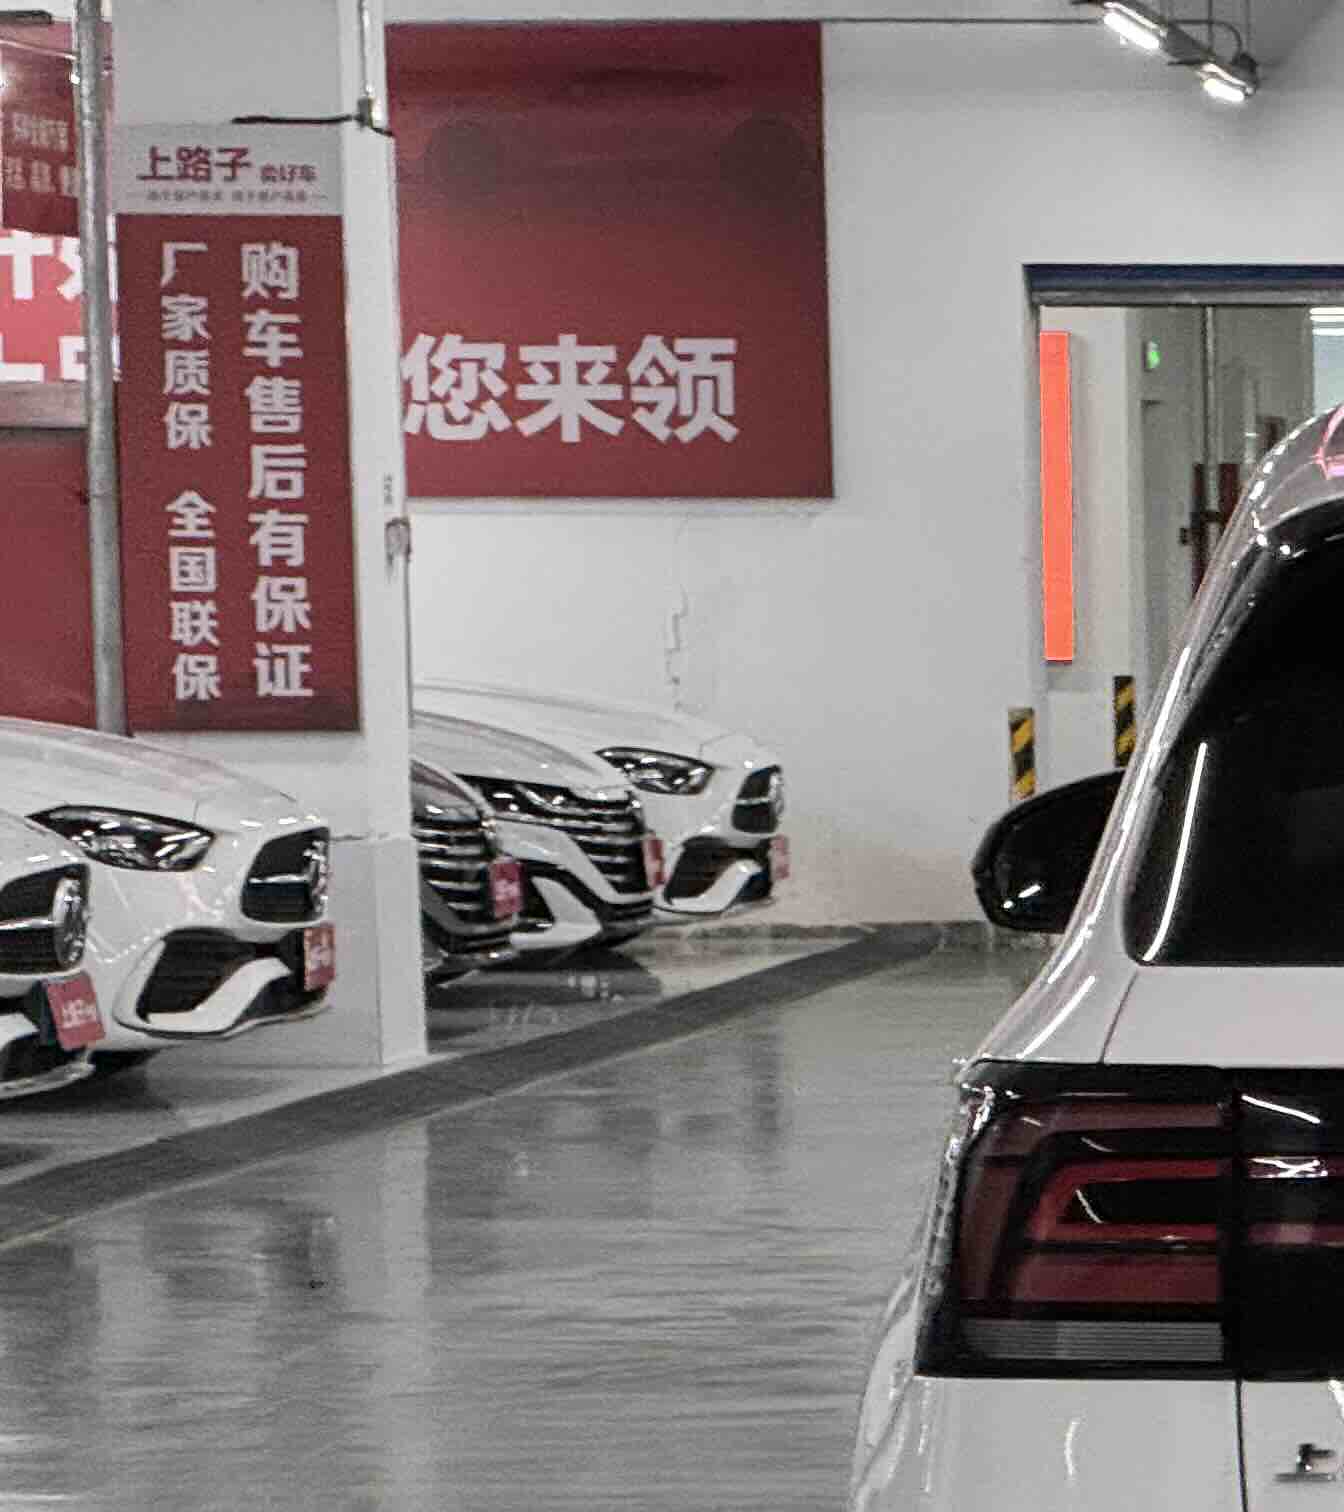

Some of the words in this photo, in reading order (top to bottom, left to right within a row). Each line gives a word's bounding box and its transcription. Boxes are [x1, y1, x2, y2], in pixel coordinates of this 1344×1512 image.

[136, 146, 251, 182] 上路子
[159, 241, 214, 451] 厂家质保
[400, 332, 741, 444] 您来领
[239, 241, 314, 699] 购车售后有保证
[164, 489, 222, 702] 全国联保
